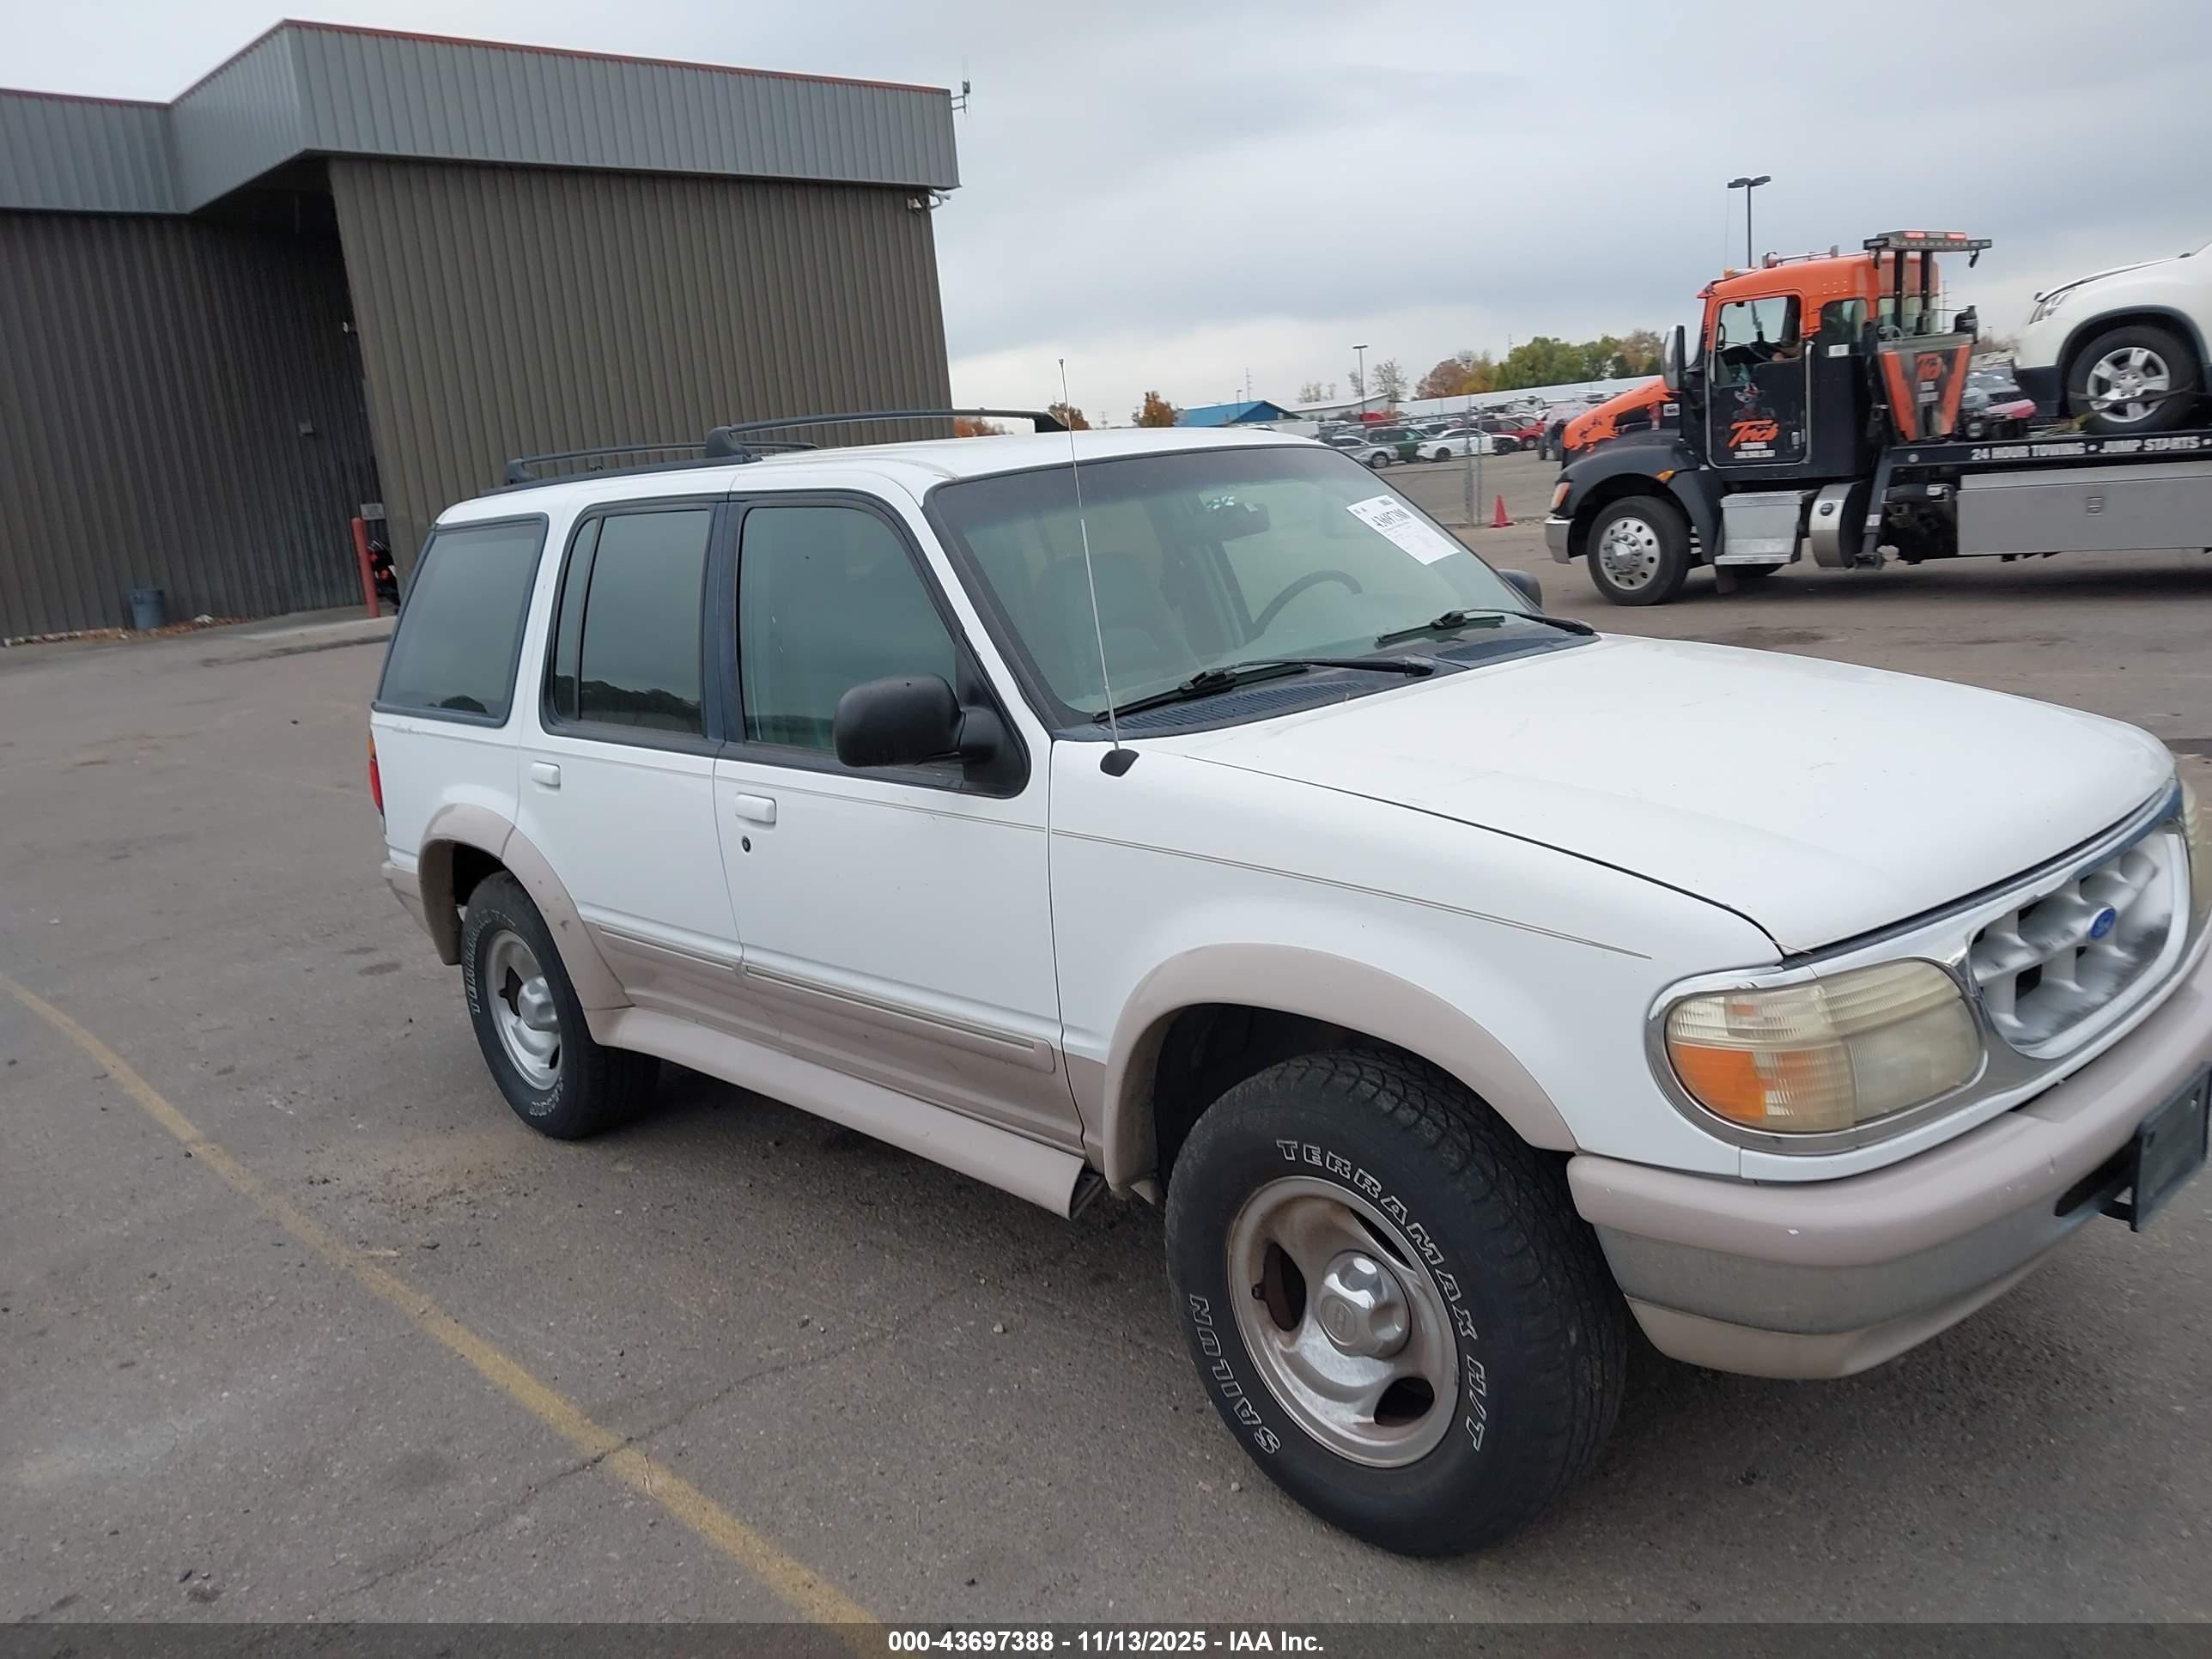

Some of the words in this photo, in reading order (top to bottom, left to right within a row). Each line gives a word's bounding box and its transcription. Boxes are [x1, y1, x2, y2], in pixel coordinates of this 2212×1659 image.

[1971, 447, 1990, 460] 24
[2144, 436, 2200, 451] STARTS
[1189, 1294, 1282, 1455] SAILUN
[1276, 1139, 1478, 1340] TERRAMAX
[1465, 1353, 1486, 1452] H/T
